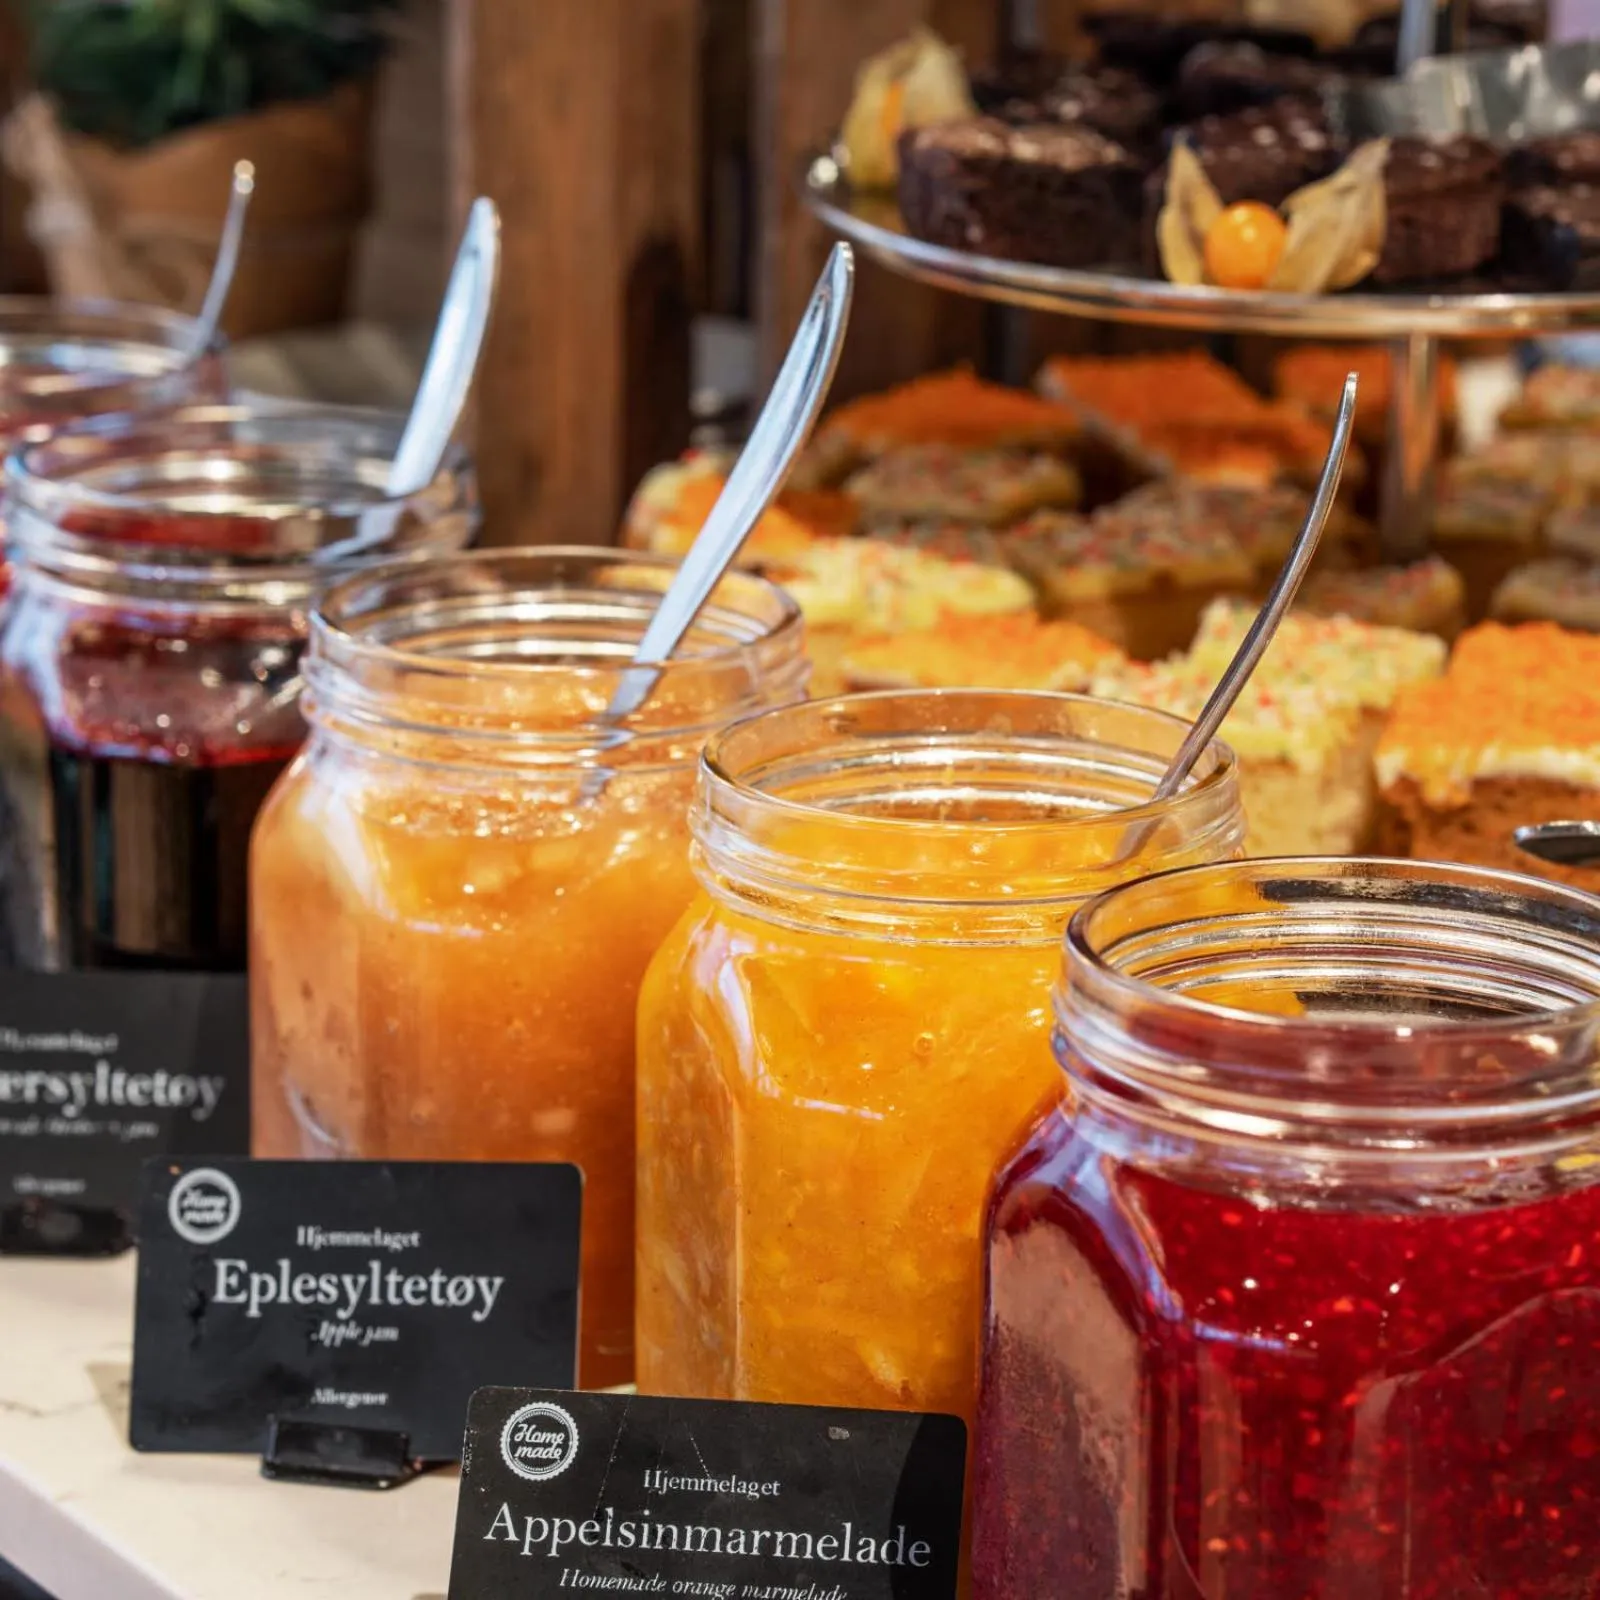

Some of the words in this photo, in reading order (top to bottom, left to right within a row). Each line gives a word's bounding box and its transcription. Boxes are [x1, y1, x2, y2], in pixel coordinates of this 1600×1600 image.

[296, 1225, 420, 1252] Hjemmelaget
[213, 1258, 504, 1321] Eplesyltetøy
[514, 1424, 565, 1444] Home
[513, 1441, 562, 1460] made
[643, 1469, 781, 1500] Hjemmelaget
[483, 1502, 932, 1568] Appelsinmarmelade
[559, 1568, 666, 1591] Homemade
[672, 1579, 736, 1600] orange
